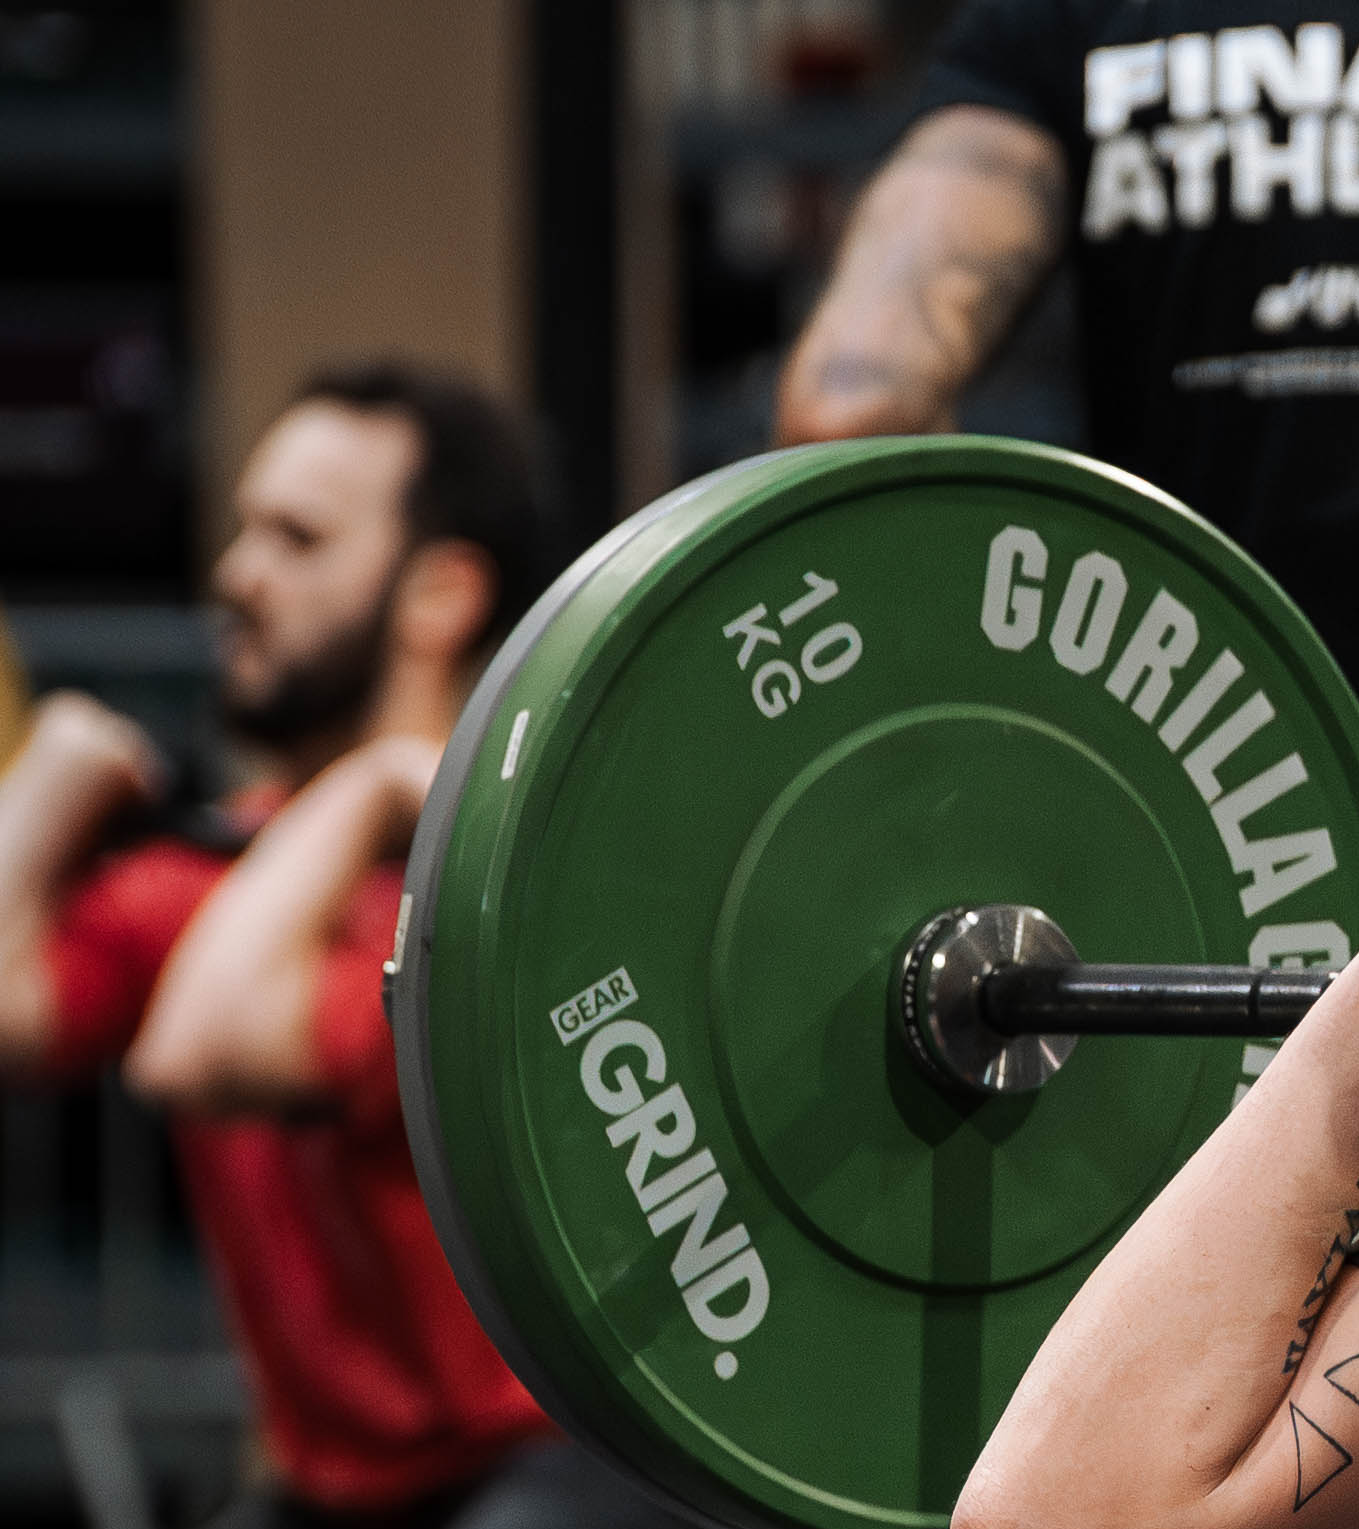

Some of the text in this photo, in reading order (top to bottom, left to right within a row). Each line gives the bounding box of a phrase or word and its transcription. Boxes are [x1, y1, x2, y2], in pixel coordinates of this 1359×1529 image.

[722, 602, 802, 719] KG
[778, 571, 863, 684] 10
[980, 524, 1338, 919] GORILLA
[556, 975, 632, 1035] GEAR
[580, 1019, 770, 1380] GRIND.
